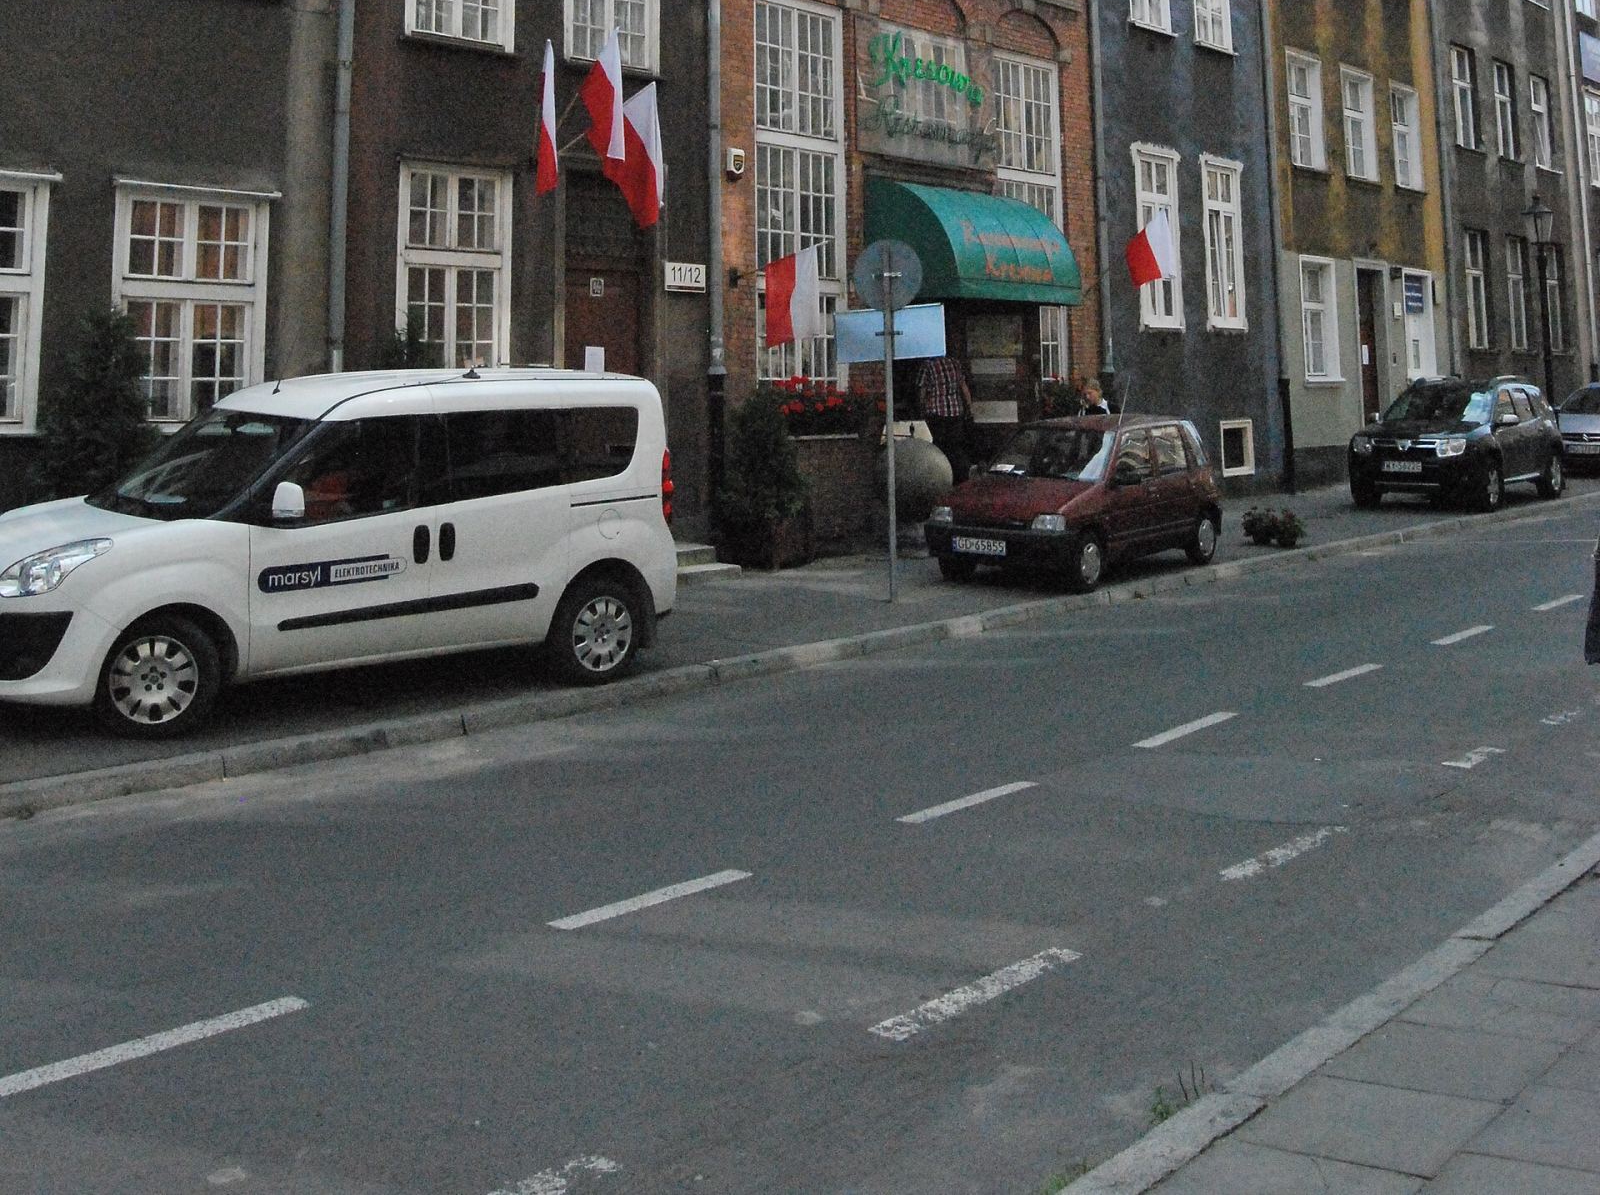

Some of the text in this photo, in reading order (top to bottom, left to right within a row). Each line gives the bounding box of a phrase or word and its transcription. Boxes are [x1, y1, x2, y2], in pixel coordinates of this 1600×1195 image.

[671, 266, 701, 284] 11/12
[268, 561, 400, 587] marsyl ELEKTROTECHNIKA
